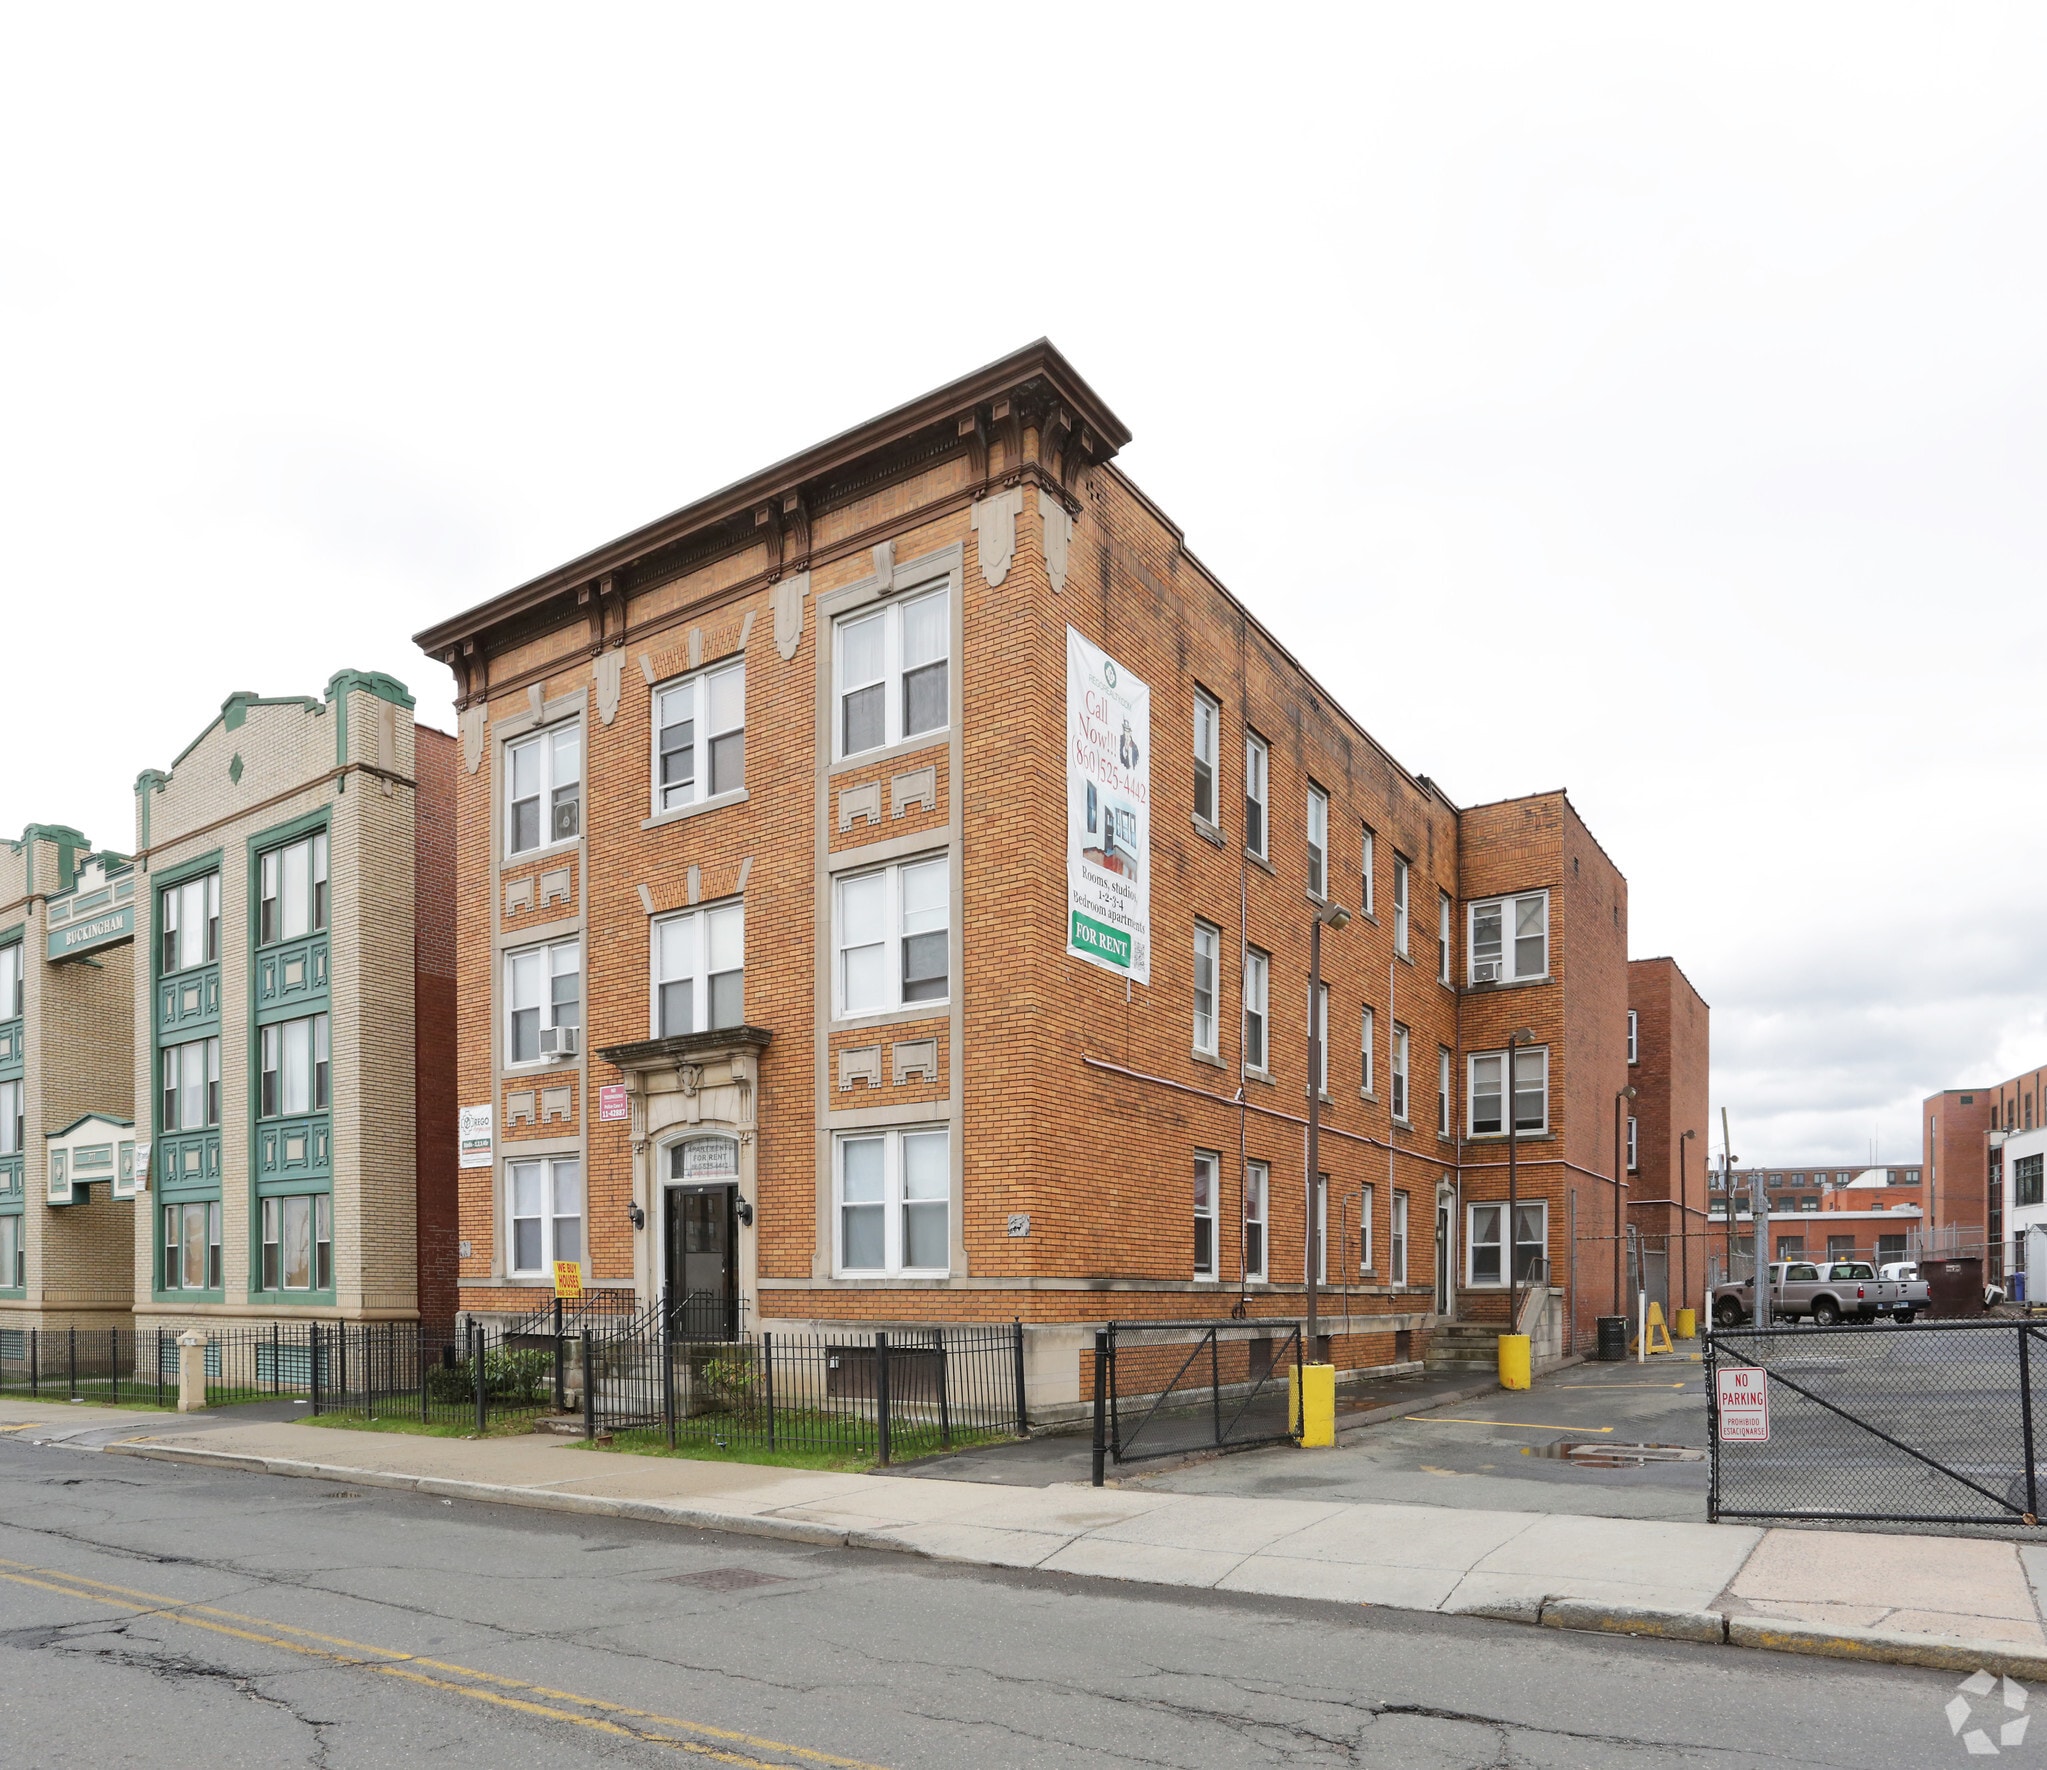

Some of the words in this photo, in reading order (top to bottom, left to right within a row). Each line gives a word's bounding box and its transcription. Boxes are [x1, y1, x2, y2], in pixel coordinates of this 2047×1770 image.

[1085, 690, 1108, 725] Call
[1079, 711, 1117, 758] Now!!!
[1082, 865, 1110, 892] Rooms,
[1073, 890, 1106, 917] Bedroom
[1107, 909, 1146, 934] apartments
[66, 914, 124, 946] BUCKINGHAM
[1075, 922, 1098, 946] FOR
[1099, 932, 1128, 957] RENT
[474, 1116, 490, 1126] REGO
[688, 1144, 734, 1153] APARTMENTS
[708, 1153, 727, 1161] RENT
[557, 1263, 566, 1273] WE
[566, 1263, 577, 1273] BUY
[558, 1274, 579, 1289] HOUSES
[1735, 1373, 1749, 1387] NO
[1722, 1392, 1764, 1406] PARKING
[1727, 1418, 1760, 1426] PROHIBIDO
[1723, 1427, 1765, 1436] ESTACIONARSE
